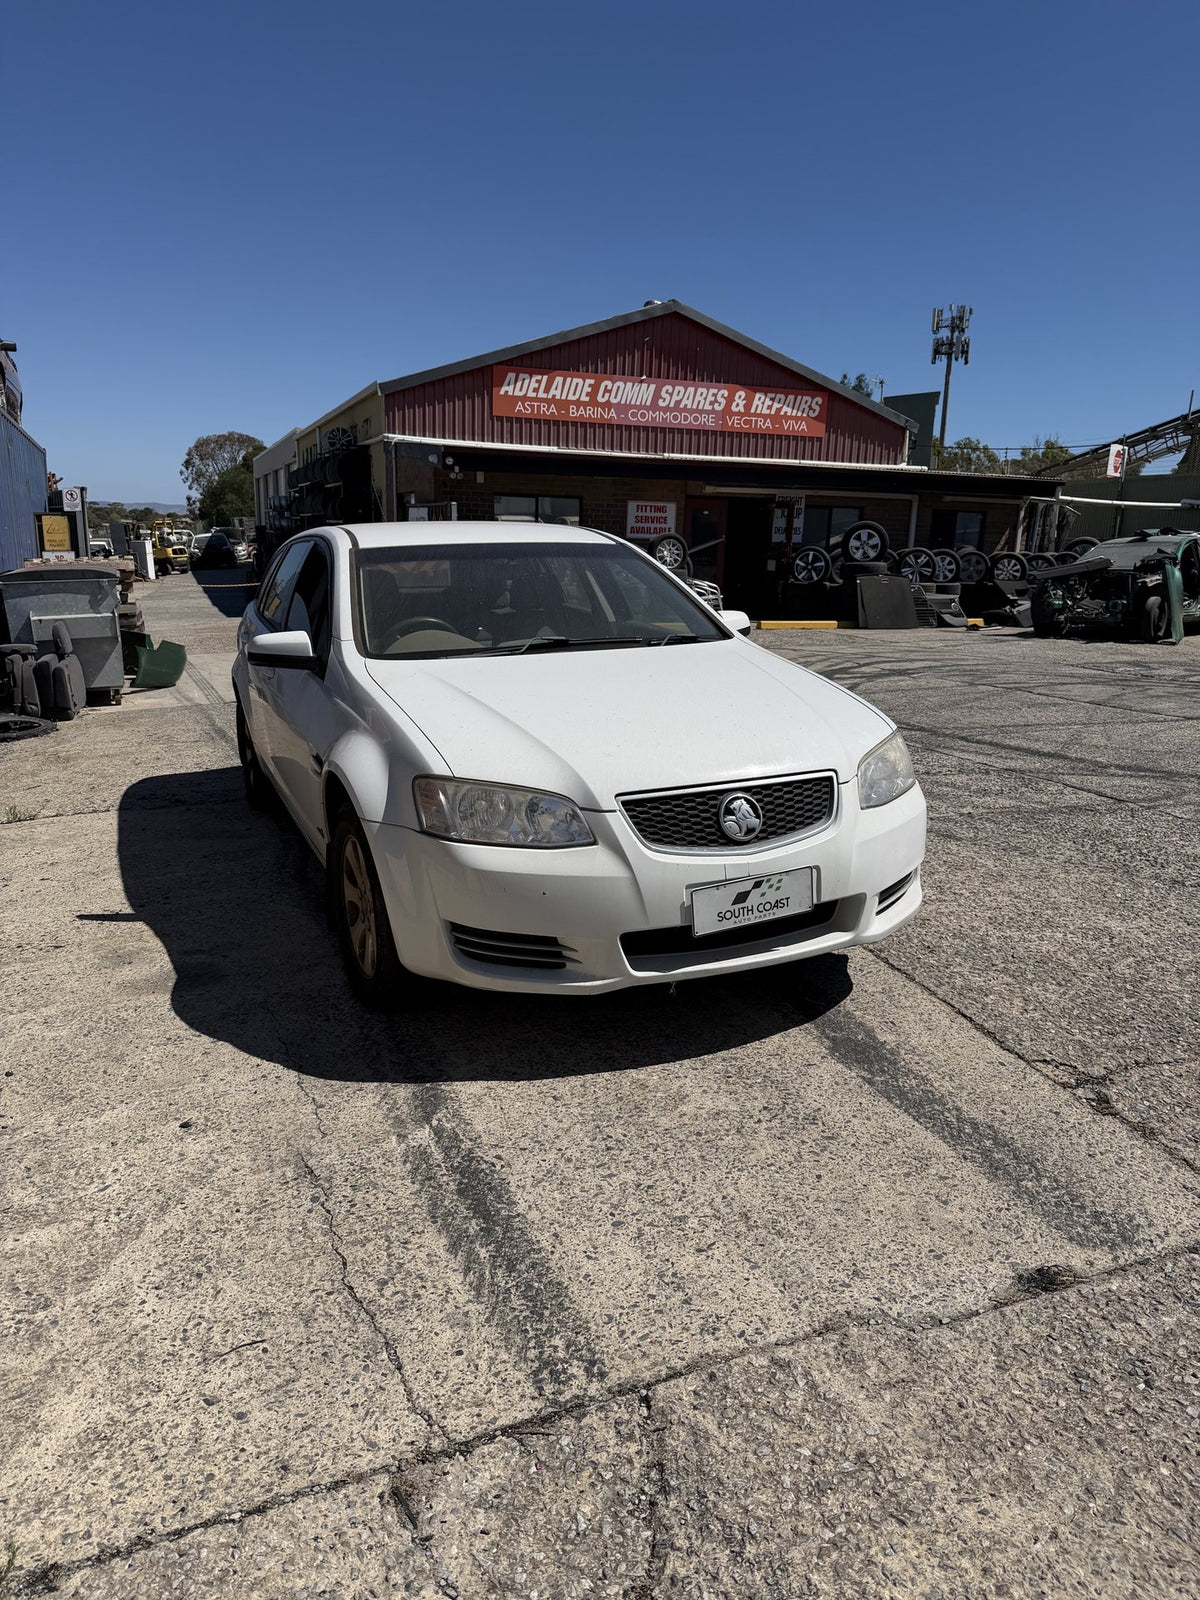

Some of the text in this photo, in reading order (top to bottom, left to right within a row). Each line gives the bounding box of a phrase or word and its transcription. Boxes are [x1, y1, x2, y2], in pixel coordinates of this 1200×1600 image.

[499, 371, 823, 418] ADELAIDE COMM SPARES & REPAIRS
[514, 401, 558, 416] ASTRA
[569, 405, 617, 420] BARINA
[628, 409, 716, 426] COMMODORE
[726, 415, 773, 430] VECTRA
[782, 419, 808, 433] VIVA
[636, 504, 668, 513] FITTING
[634, 515, 668, 525] SERVICE
[717, 896, 791, 922] SOUTH COAST
[733, 912, 776, 925] AUTO PARTS
